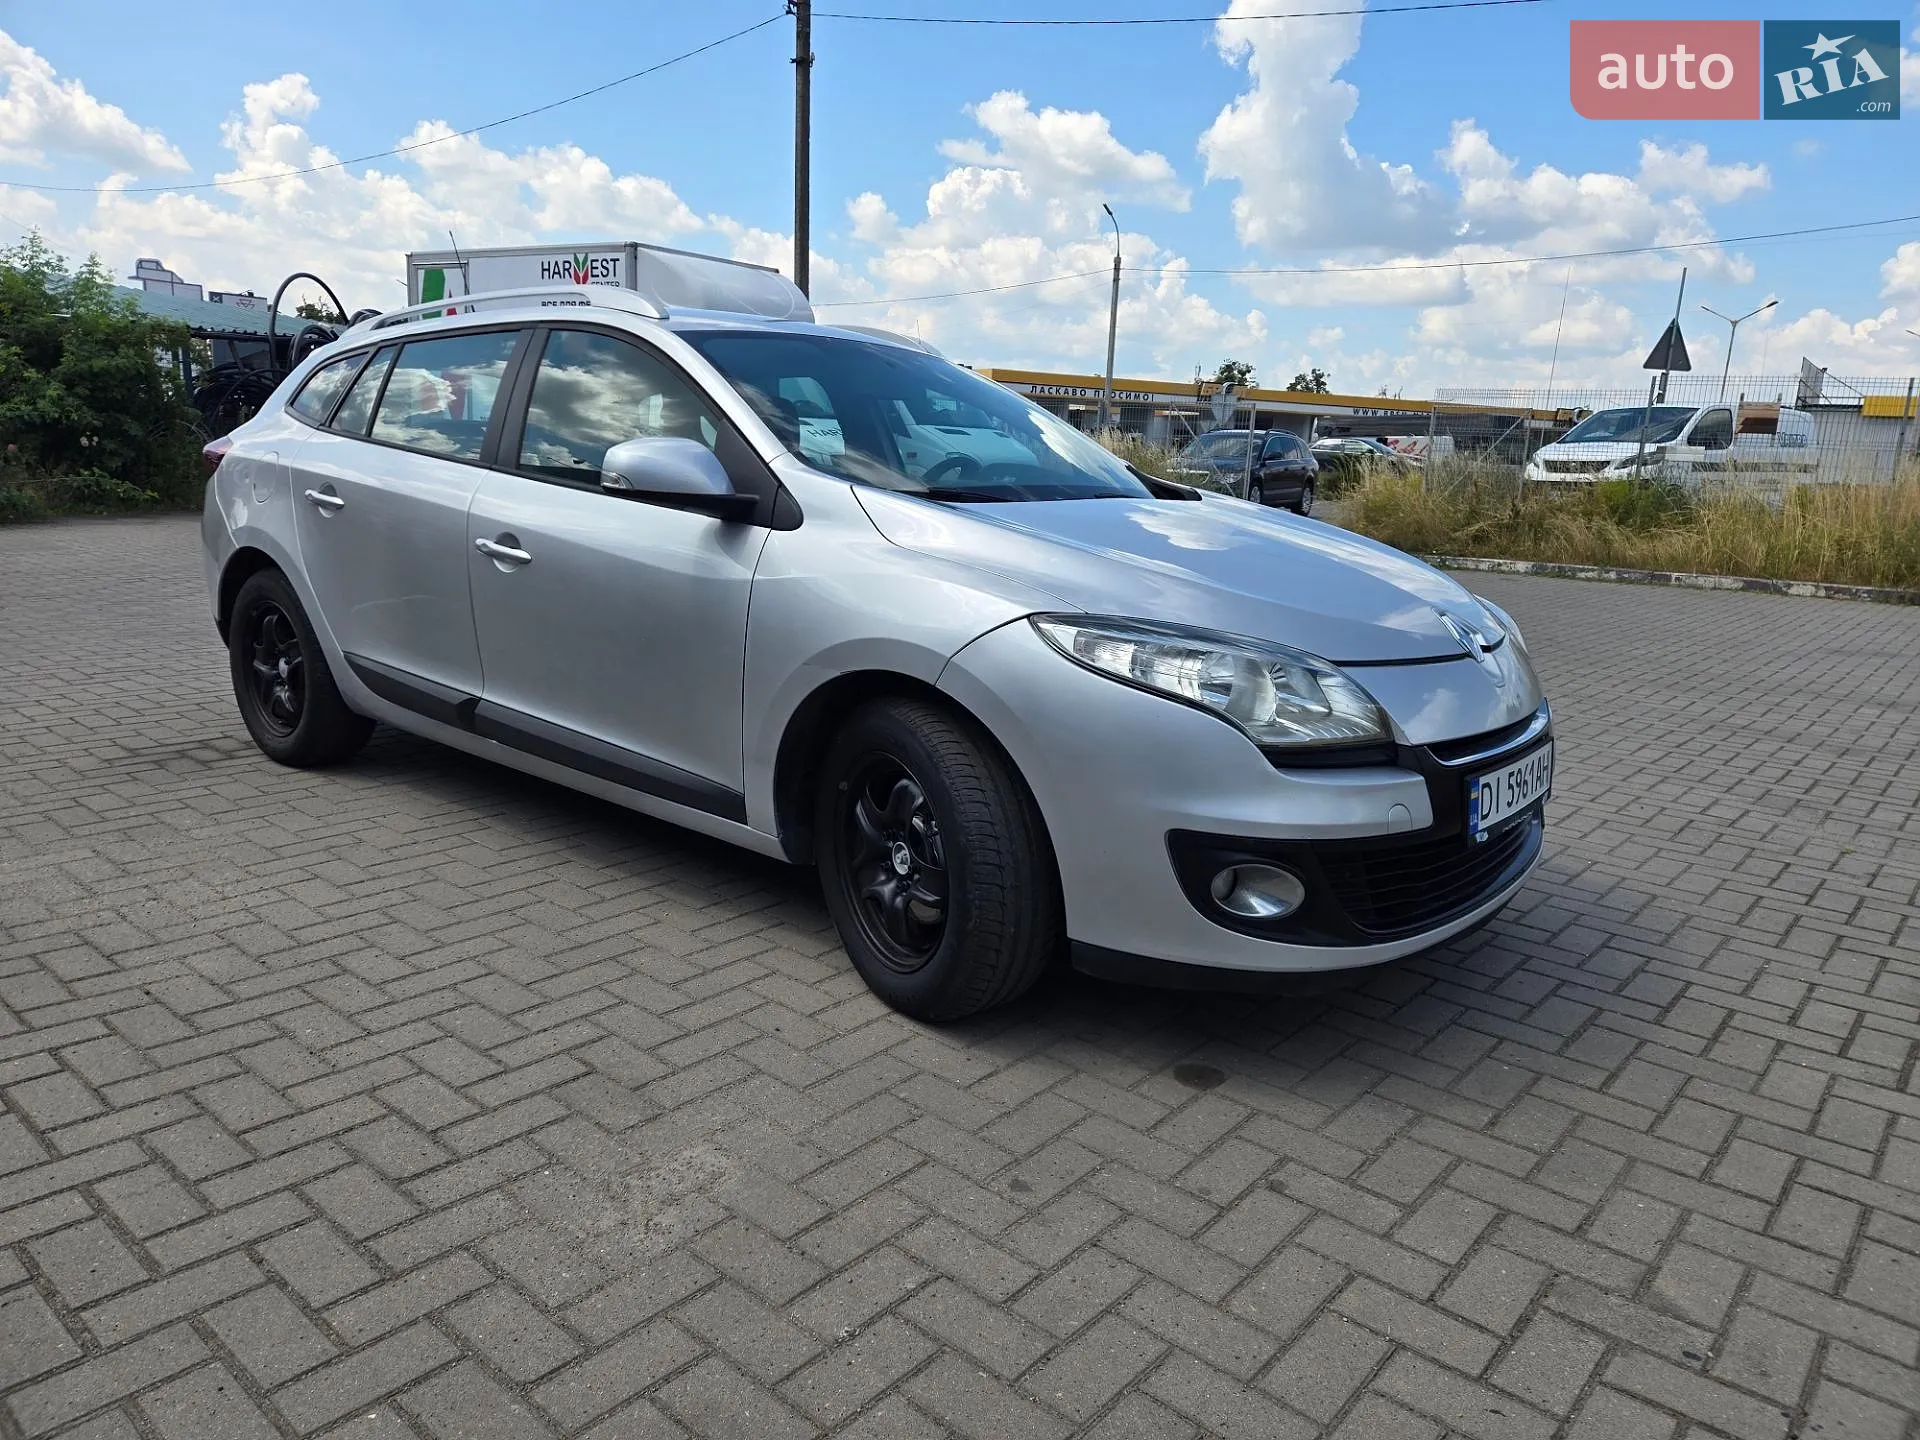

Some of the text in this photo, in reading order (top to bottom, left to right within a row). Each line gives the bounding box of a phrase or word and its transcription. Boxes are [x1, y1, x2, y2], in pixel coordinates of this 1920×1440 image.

[541, 252, 620, 285] HARVEST
[1030, 385, 1087, 397] ЛАСКАВО
[1481, 777, 1500, 821] DI
